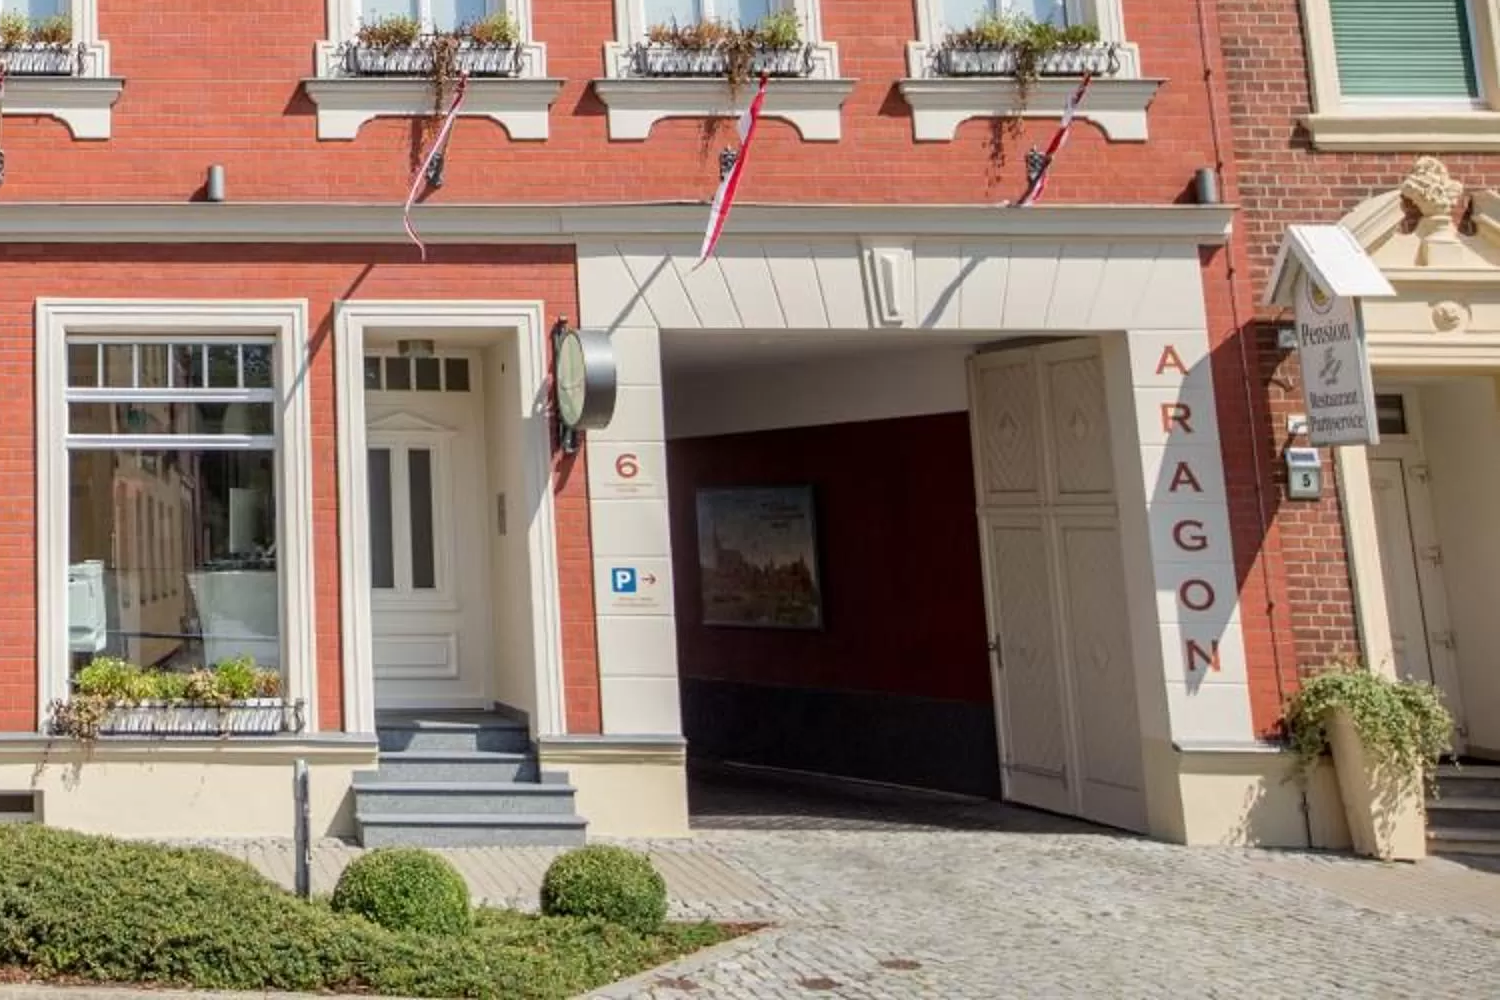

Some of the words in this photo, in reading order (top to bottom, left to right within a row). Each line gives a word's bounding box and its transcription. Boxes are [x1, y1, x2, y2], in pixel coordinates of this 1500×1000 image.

[1301, 322, 1351, 347] Pension
[616, 453, 638, 478] 6
[1302, 474, 1311, 488] 5
[1156, 344, 1221, 673] ARAGON
[616, 570, 631, 590] P
